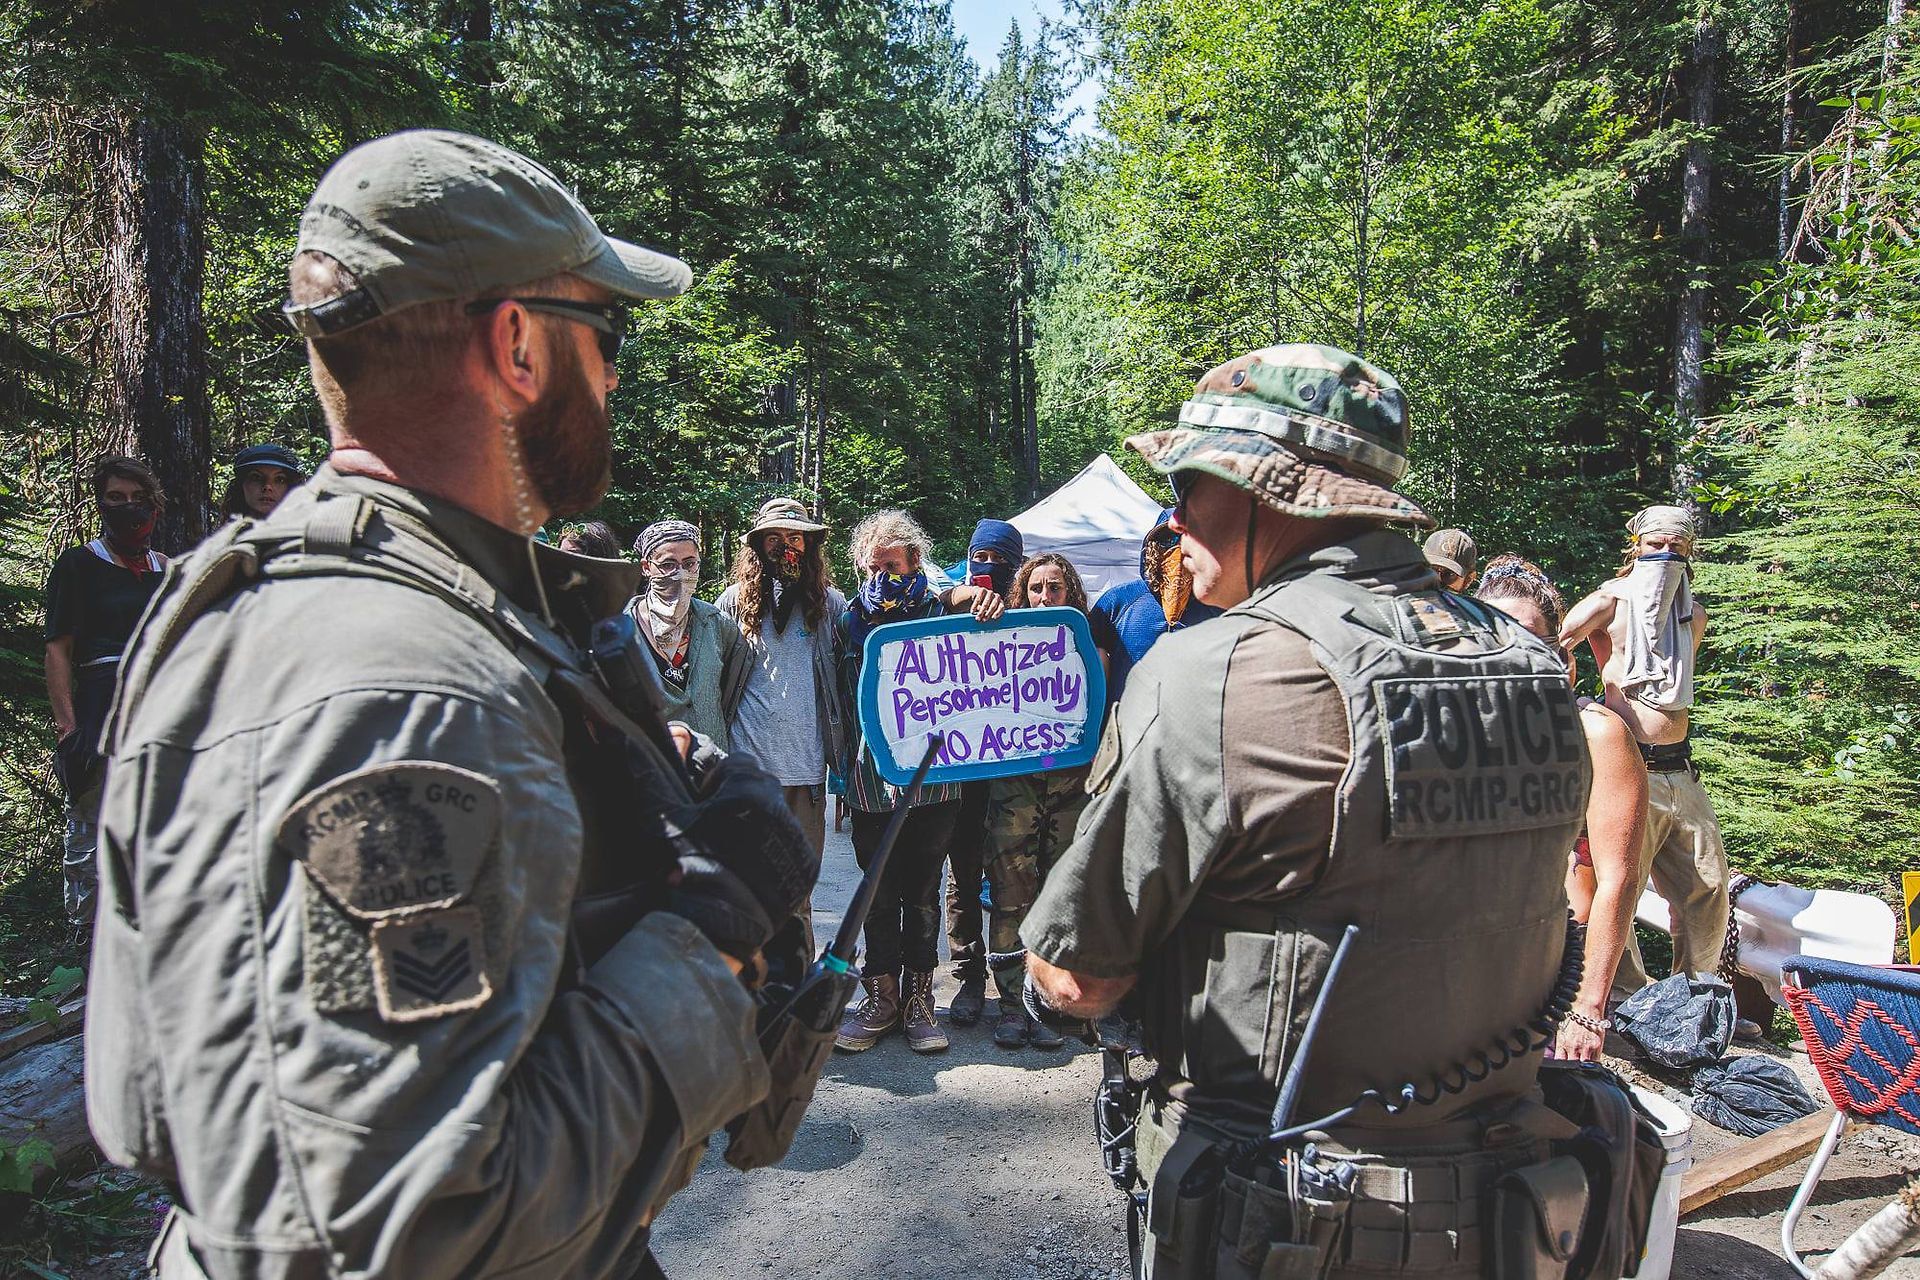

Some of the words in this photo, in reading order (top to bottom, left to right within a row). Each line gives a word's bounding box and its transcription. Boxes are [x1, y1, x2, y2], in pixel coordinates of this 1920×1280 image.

[892, 673, 1020, 739] Personnel
[1021, 666, 1082, 713] only
[1386, 686, 1581, 771] POLICE
[926, 730, 972, 766] NO
[978, 722, 1066, 761] ACCESS
[302, 790, 369, 840] RCMP
[426, 783, 477, 813] GRC
[1397, 771, 1583, 824] RCMP-GRC
